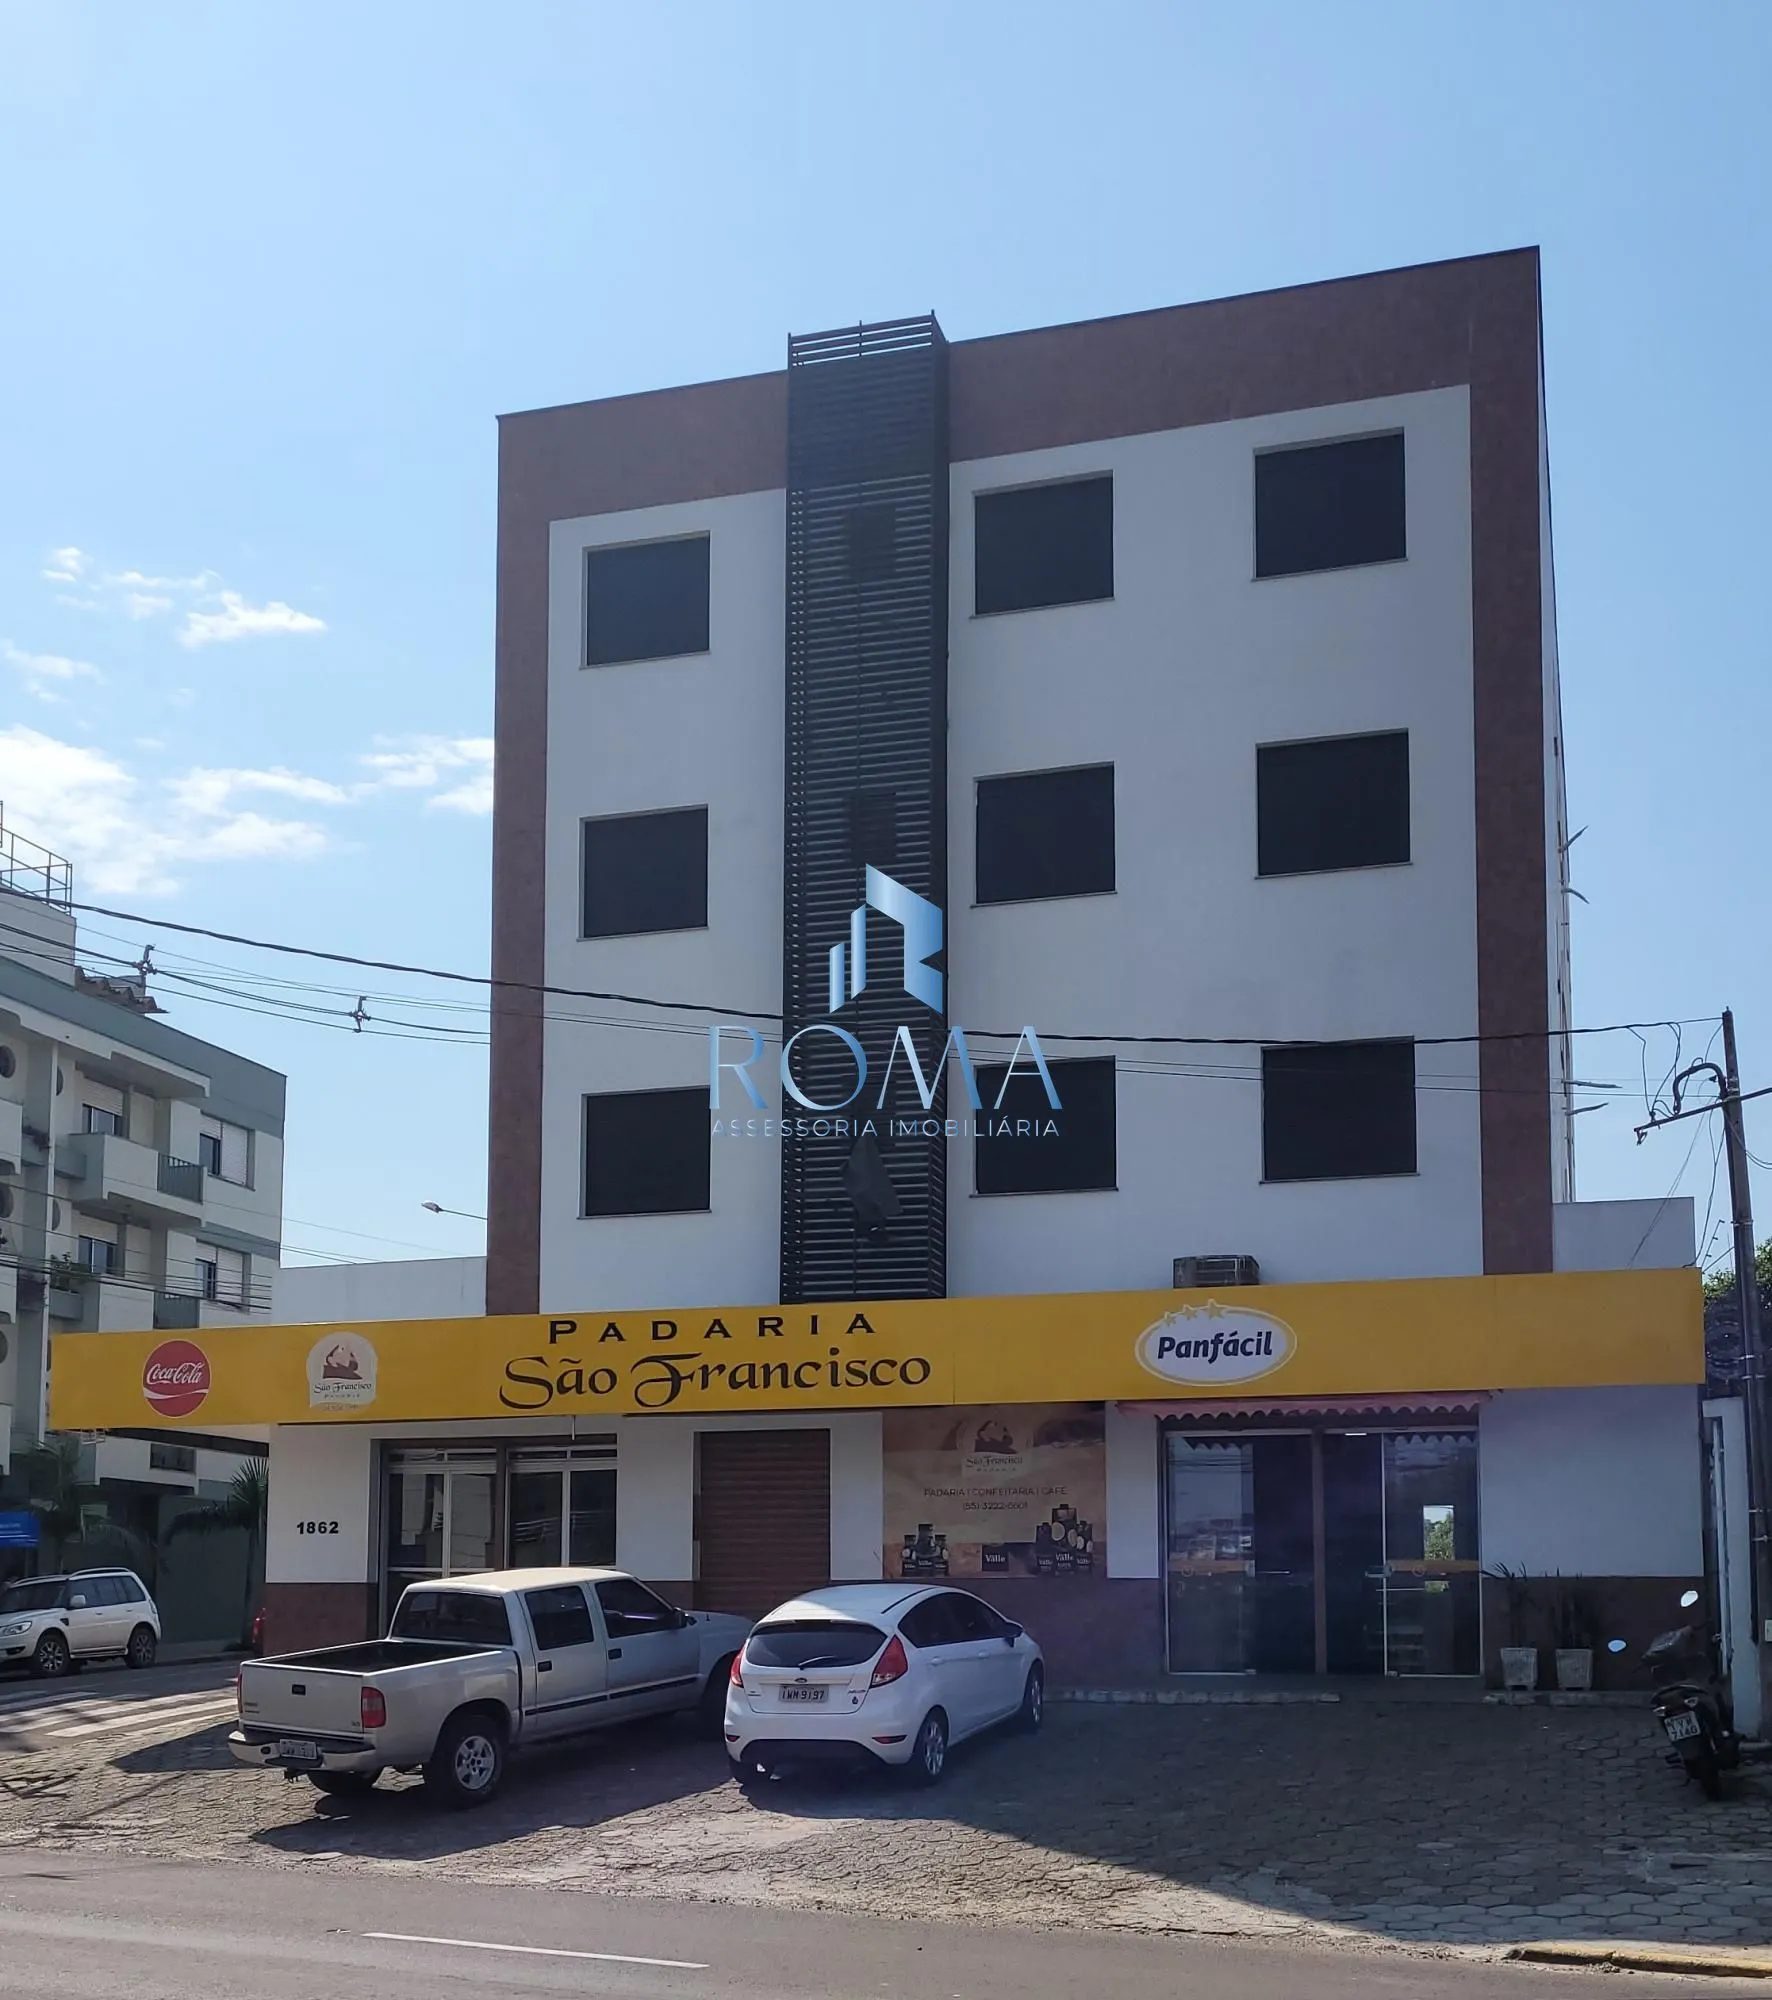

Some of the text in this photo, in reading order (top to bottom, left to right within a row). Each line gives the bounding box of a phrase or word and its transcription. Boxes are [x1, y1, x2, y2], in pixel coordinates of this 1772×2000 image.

[548, 1313, 876, 1344] PADARIA
[1157, 1330, 1273, 1364] Panfácil
[146, 1362, 205, 1385] Coca-Cola
[499, 1347, 931, 1410] São Francisco
[924, 1487, 965, 1497] PADARIA
[971, 1487, 1034, 1497] CONFEITARIA
[296, 1521, 339, 1534] 1862
